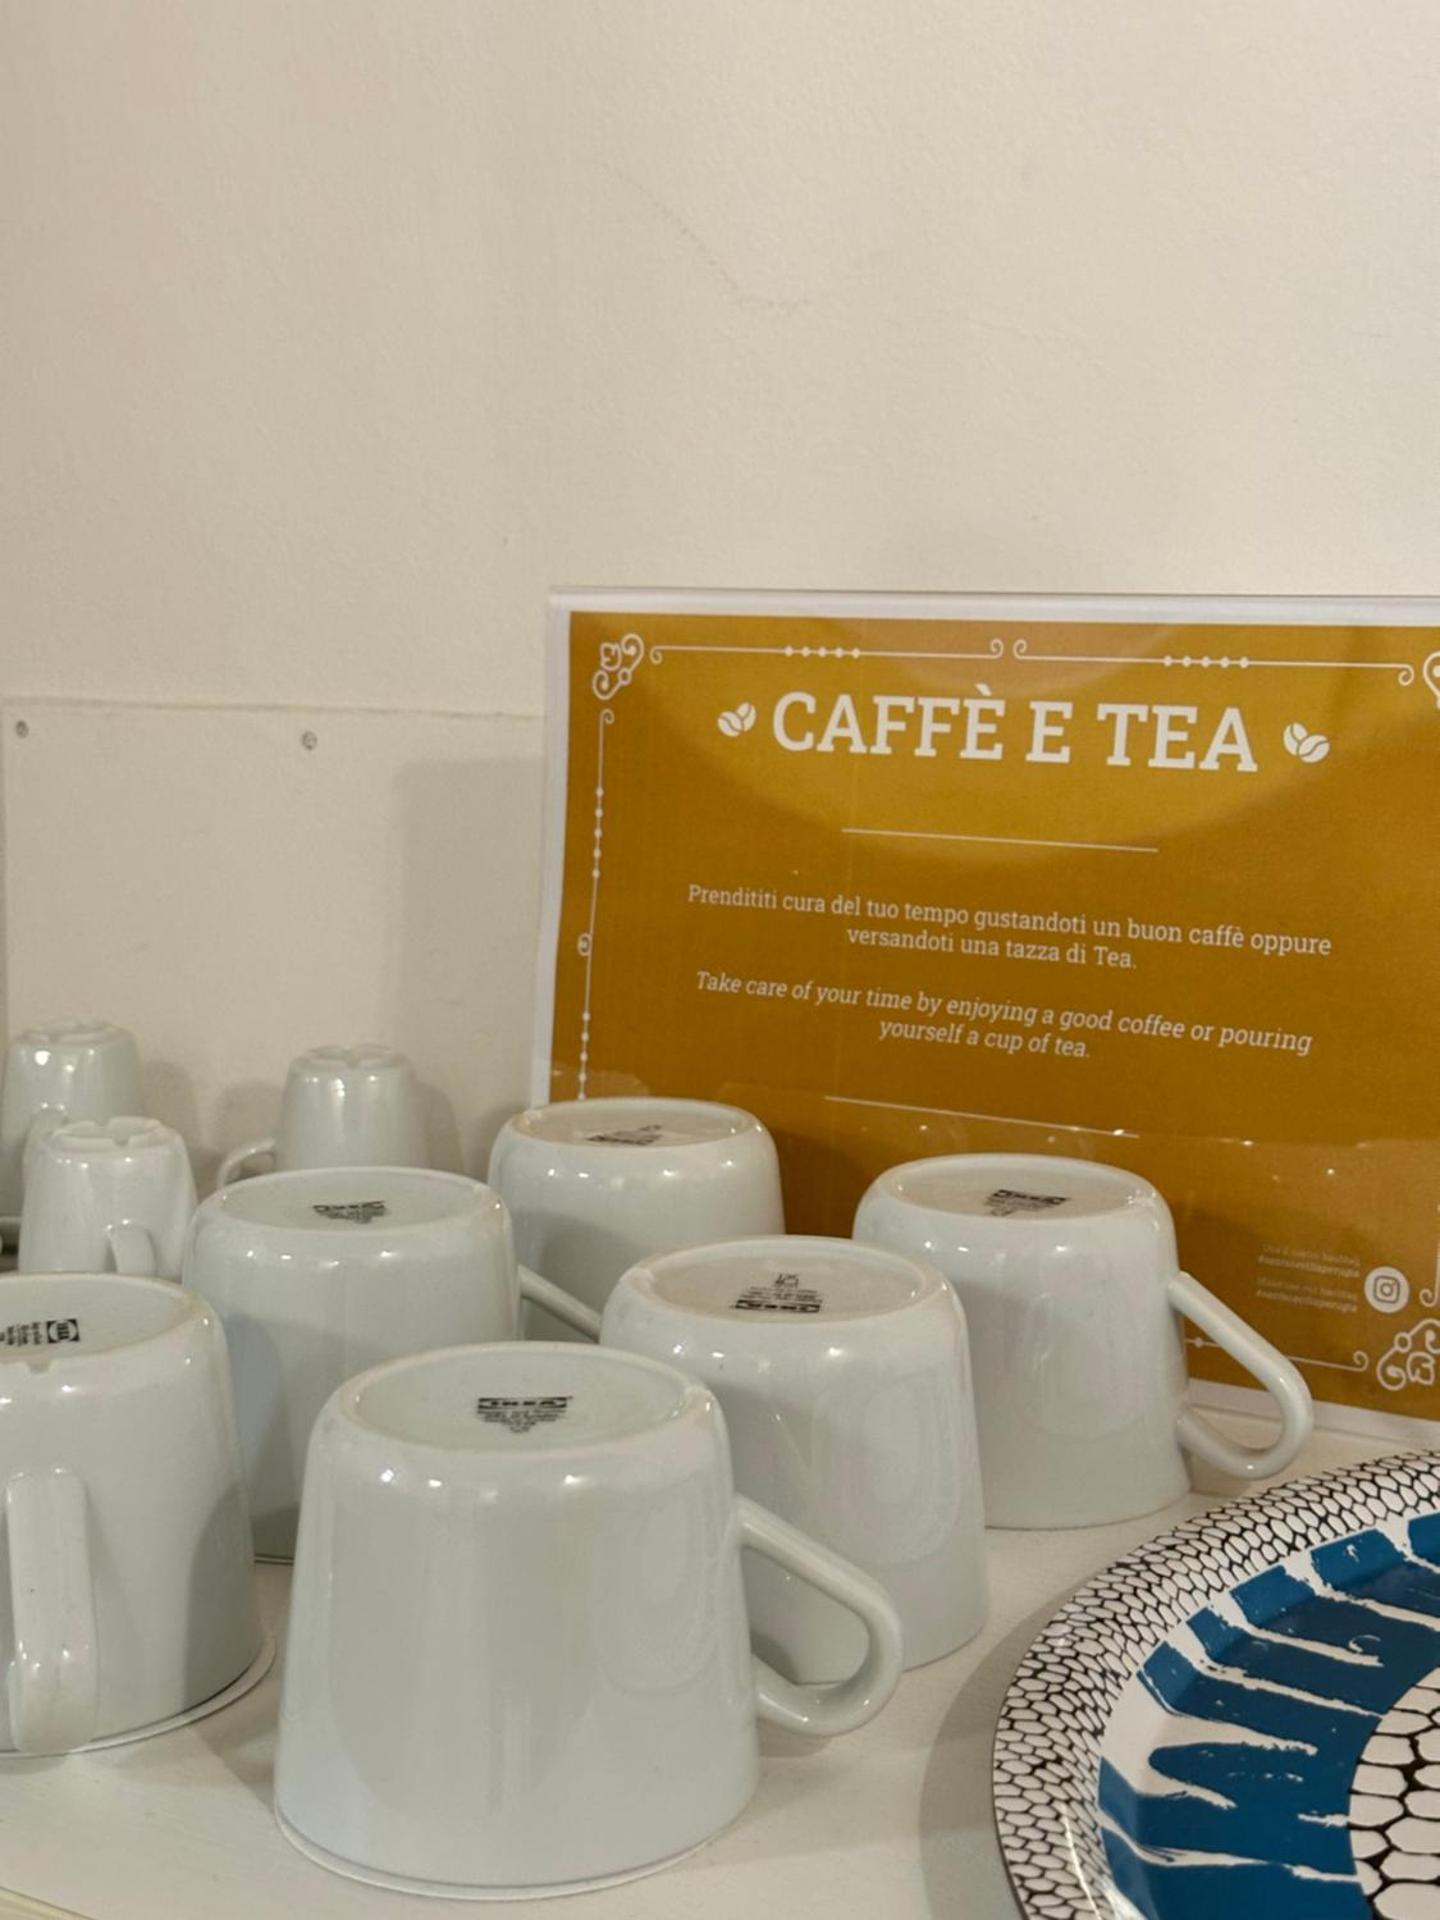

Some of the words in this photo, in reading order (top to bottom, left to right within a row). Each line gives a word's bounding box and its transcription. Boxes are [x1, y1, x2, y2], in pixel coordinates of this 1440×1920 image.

[773, 683, 1005, 761] CAFFÈ
[1025, 701, 1073, 764] E
[1097, 703, 1258, 773] TEA
[688, 884, 777, 910] Prendititi
[782, 894, 826, 914] cura
[831, 895, 861, 917] del
[866, 900, 899, 919] tuo
[904, 903, 970, 928] tempo
[974, 911, 1087, 935] gustandoti
[1092, 917, 1121, 938] un
[1126, 917, 1183, 943] buon
[1188, 924, 1245, 949] caffè
[1250, 931, 1333, 957] oppure
[847, 927, 955, 954] versandoti
[960, 936, 1000, 957] una
[1005, 940, 1061, 963] tazza
[1066, 942, 1087, 966] di
[1093, 945, 1138, 970] Tea.
[696, 970, 742, 995] Take
[745, 977, 788, 999] care
[791, 980, 813, 1001] of
[816, 985, 861, 1006] your
[865, 988, 912, 1012] time
[916, 991, 942, 1018] by
[945, 998, 1039, 1028] enjoying
[1041, 1008, 1054, 1025] a
[1059, 1009, 1114, 1032] good
[1118, 1013, 1186, 1040] coffee
[1190, 1022, 1216, 1042] or
[1219, 1028, 1313, 1056] pouring
[879, 1018, 962, 1044] yourself
[967, 1028, 979, 1045] a
[984, 1031, 1024, 1056] cup
[1028, 1032, 1052, 1053] of
[1054, 1037, 1091, 1059] tea.
